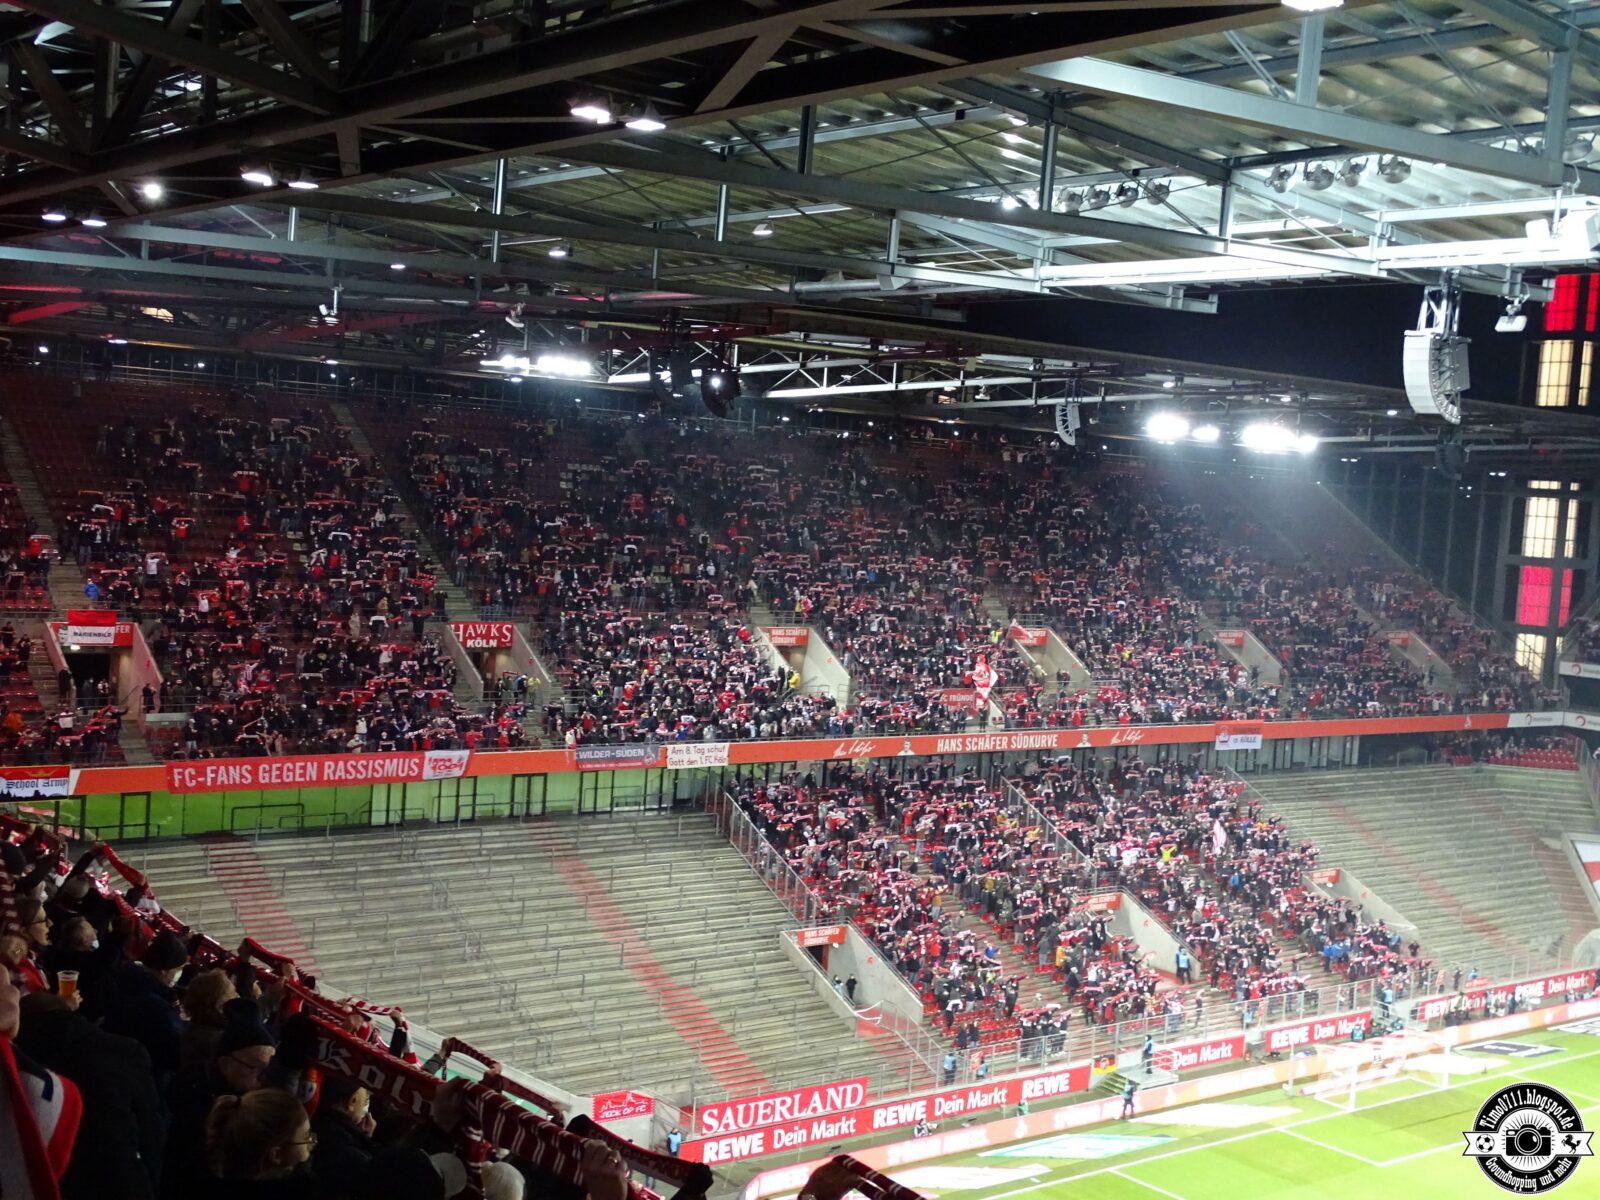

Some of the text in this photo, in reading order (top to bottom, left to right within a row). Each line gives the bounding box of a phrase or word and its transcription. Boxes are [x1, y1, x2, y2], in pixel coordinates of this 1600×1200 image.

[450, 623, 512, 642] HAWKS
[466, 637, 498, 648] KÖLN
[693, 745, 705, 756] Tag
[937, 734, 1058, 753] HANS SCHÄFER SÜDKURVE
[173, 764, 252, 788] FC-FANS
[258, 761, 317, 783] GEGEN
[323, 758, 419, 781] RASSISMUS
[687, 757, 698, 766] den
[1548, 978, 1566, 994] Dein
[1271, 1026, 1310, 1049] REWE
[1314, 1022, 1336, 1041] Dein
[1173, 1041, 1233, 1068] Dein Markt
[1021, 1072, 1070, 1101] REWE
[701, 1083, 864, 1136] SAUERLAND
[873, 1087, 1008, 1129] REWE Dein Markt
[703, 1131, 765, 1164] REWE
[773, 1123, 808, 1150] Dein
[810, 1116, 857, 1141] Markt
